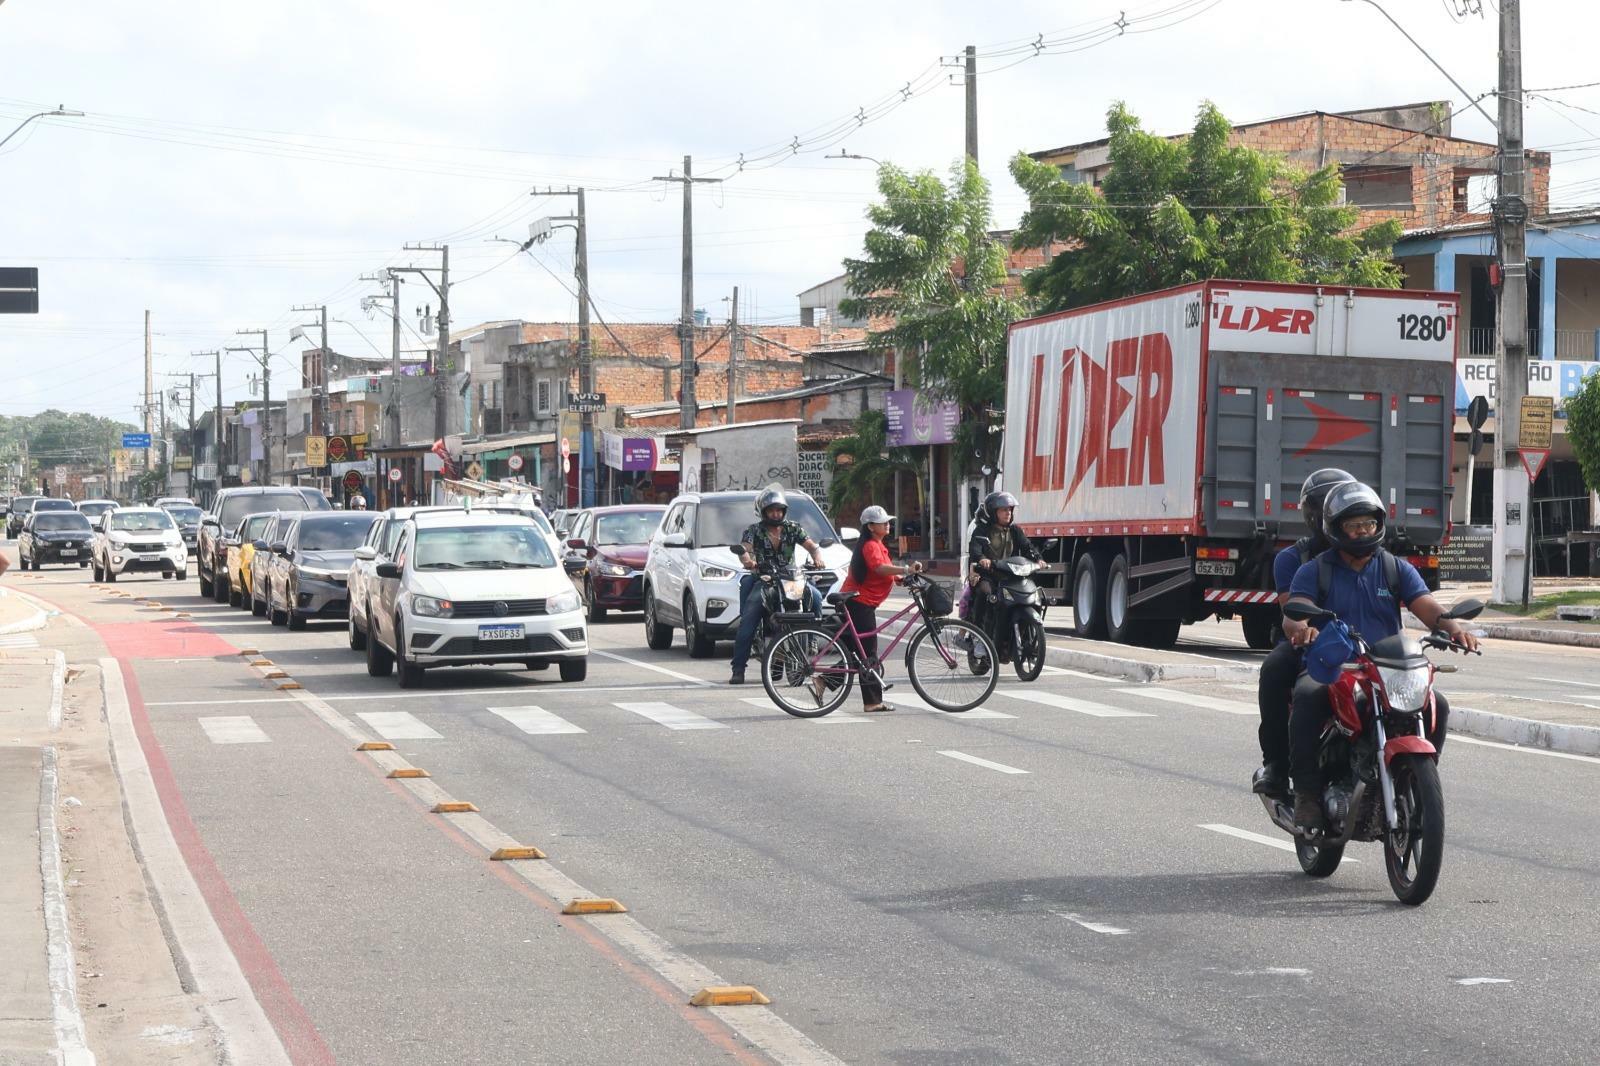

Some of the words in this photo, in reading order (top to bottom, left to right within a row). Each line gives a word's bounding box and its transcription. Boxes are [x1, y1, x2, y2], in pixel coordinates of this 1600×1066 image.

[1185, 301, 1200, 328] 1280
[1396, 314, 1447, 341] 1280
[572, 392, 600, 403] AUTO
